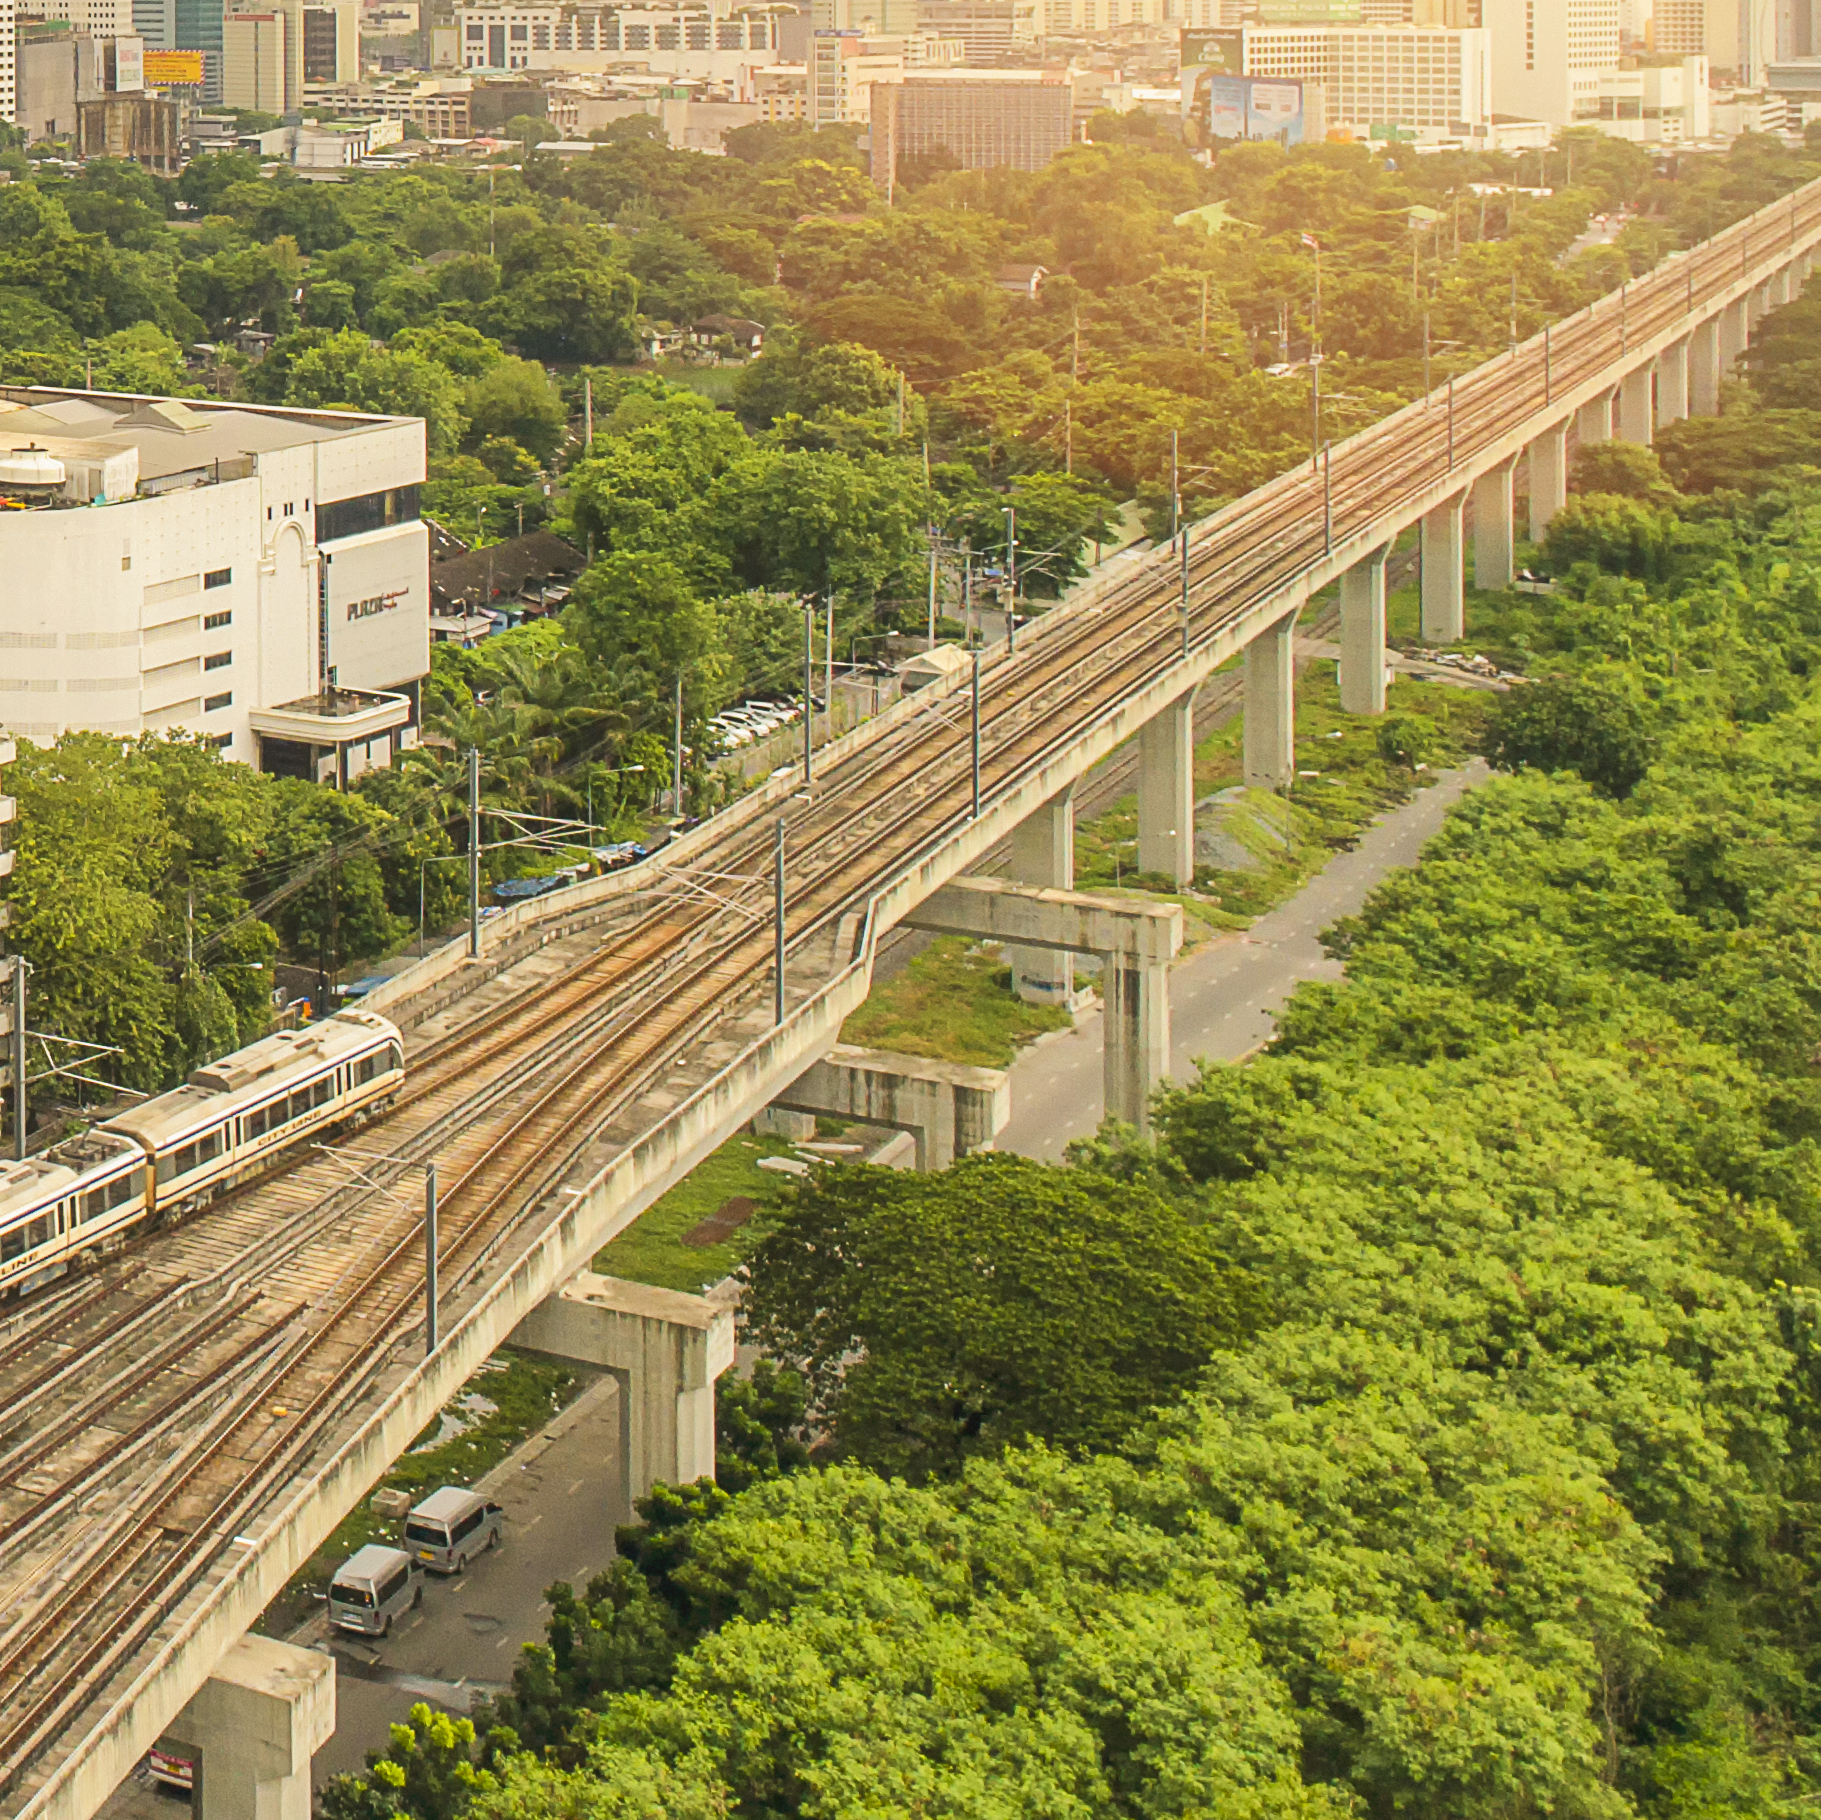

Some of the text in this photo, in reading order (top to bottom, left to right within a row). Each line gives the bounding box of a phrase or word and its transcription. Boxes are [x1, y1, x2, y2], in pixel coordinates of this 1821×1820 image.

[258, 1109, 322, 1146] CITY LINE
[1, 1250, 39, 1276] LINE
